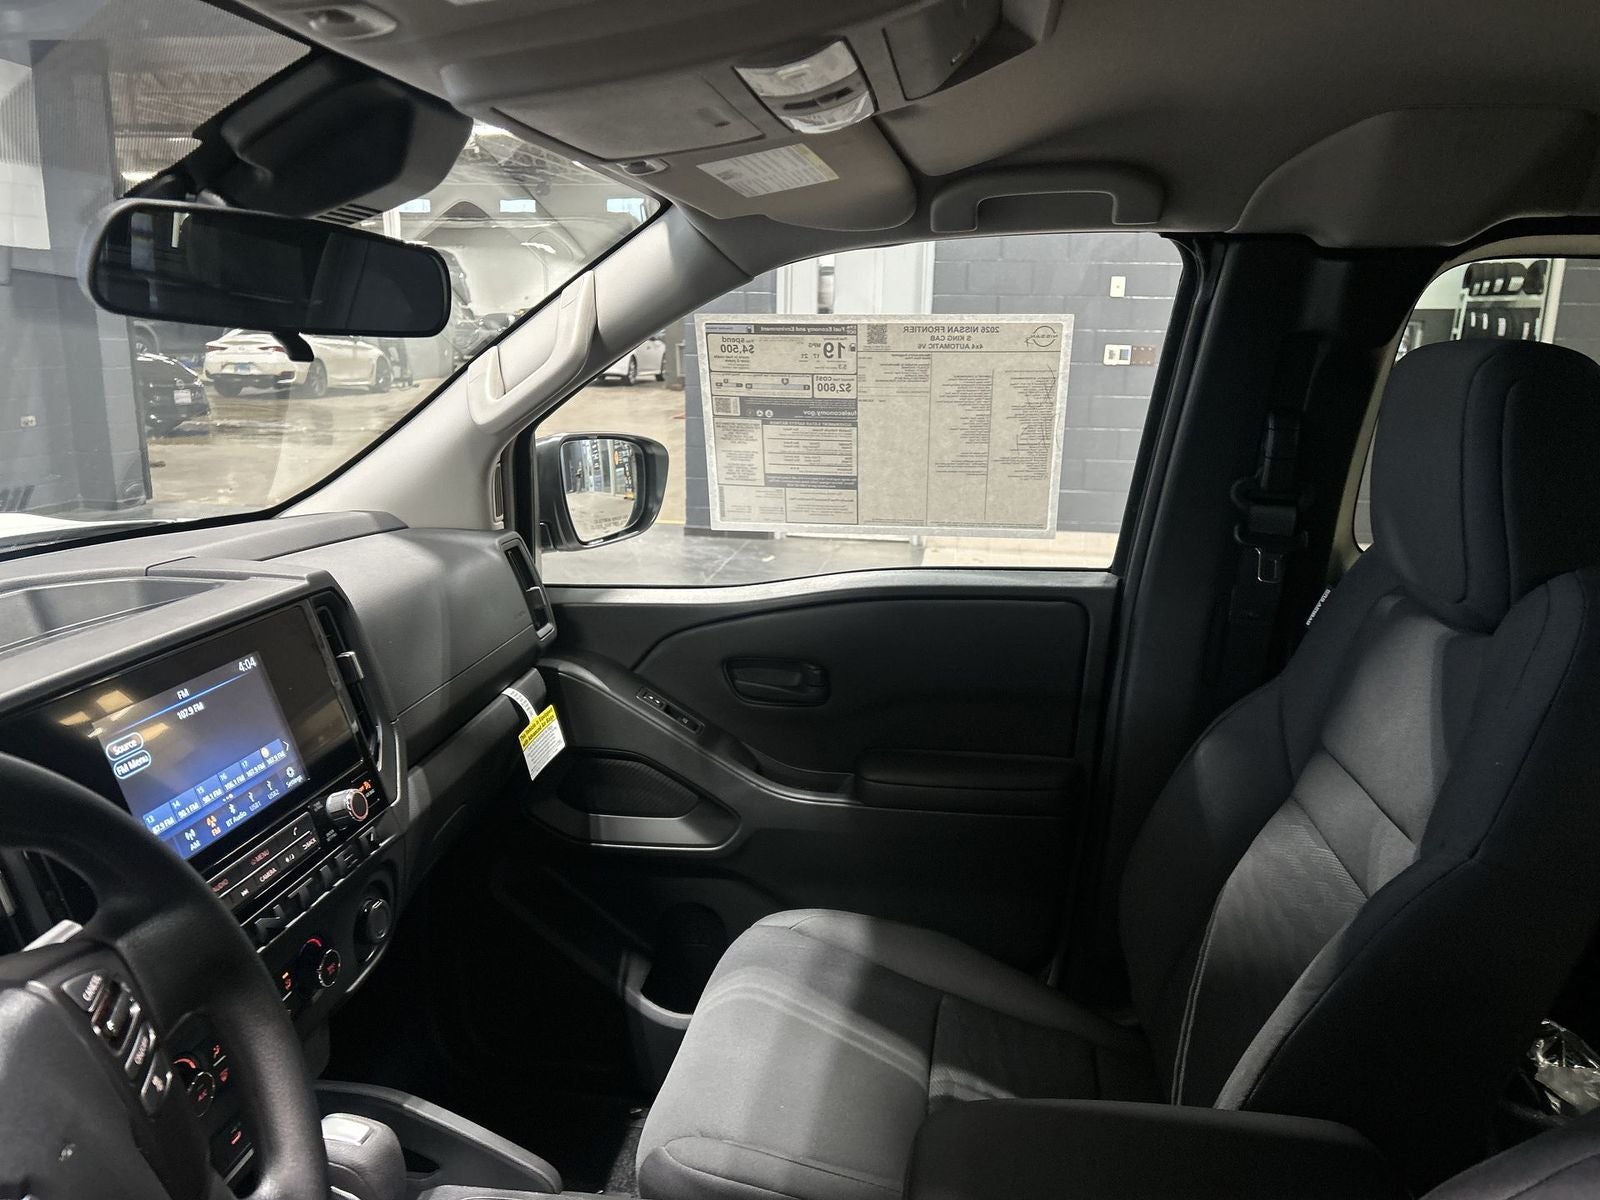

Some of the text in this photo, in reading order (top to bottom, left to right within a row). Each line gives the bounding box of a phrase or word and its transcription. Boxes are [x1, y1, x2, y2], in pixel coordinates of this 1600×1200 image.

[238, 656, 257, 672] 4:04
[176, 688, 190, 700] FM
[193, 702, 205, 714] FM
[112, 738, 138, 756] Source
[276, 750, 287, 759] FM
[116, 755, 149, 776] FM Menu
[257, 762, 266, 771] FM
[236, 774, 246, 784] FM
[212, 788, 223, 798] FM
[267, 788, 280, 800] USB2
[189, 802, 200, 812] FM
[249, 800, 262, 812] USB1
[164, 816, 175, 827] FM
[226, 811, 247, 828] BT Audio
[211, 826, 222, 837] FM
[190, 840, 201, 851] AM
[255, 850, 270, 863] MENU
[259, 867, 277, 883] CAMERA
[82, 974, 102, 1001] CANCEL
